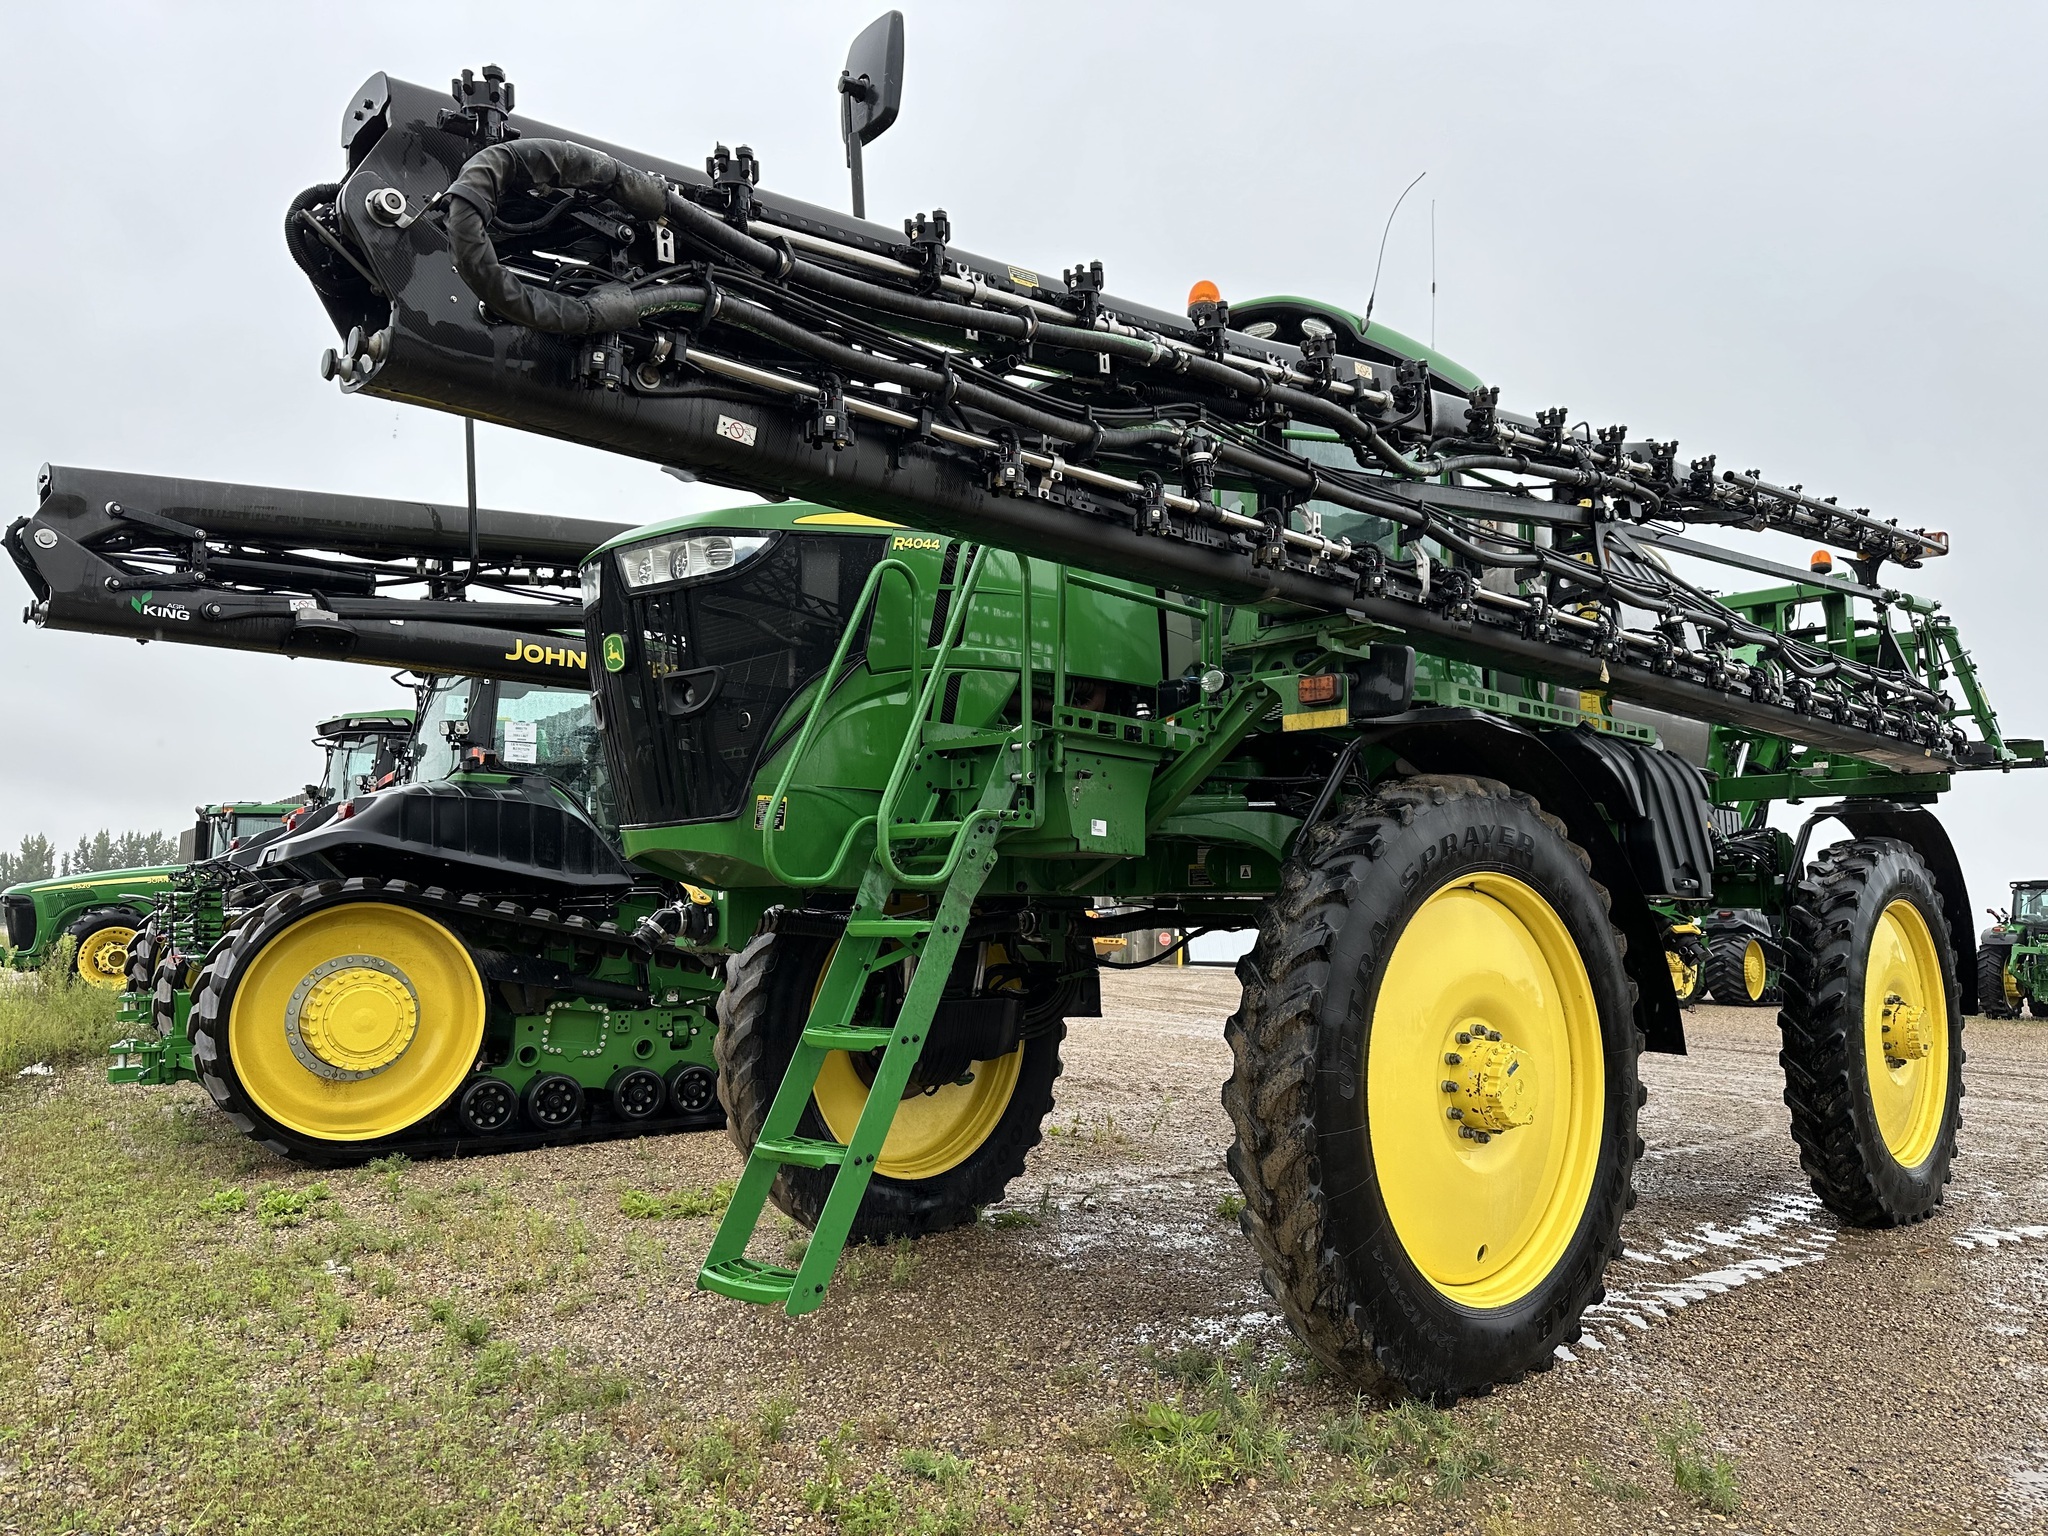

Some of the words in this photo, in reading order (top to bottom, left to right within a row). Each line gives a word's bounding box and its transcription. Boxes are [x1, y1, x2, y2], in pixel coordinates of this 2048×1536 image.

[892, 536, 941, 551] R4044
[143, 604, 190, 621] KING
[505, 638, 587, 670] JOHN
[1400, 824, 1535, 896] SPRAYER
[1338, 920, 1389, 1101] ULTRA
